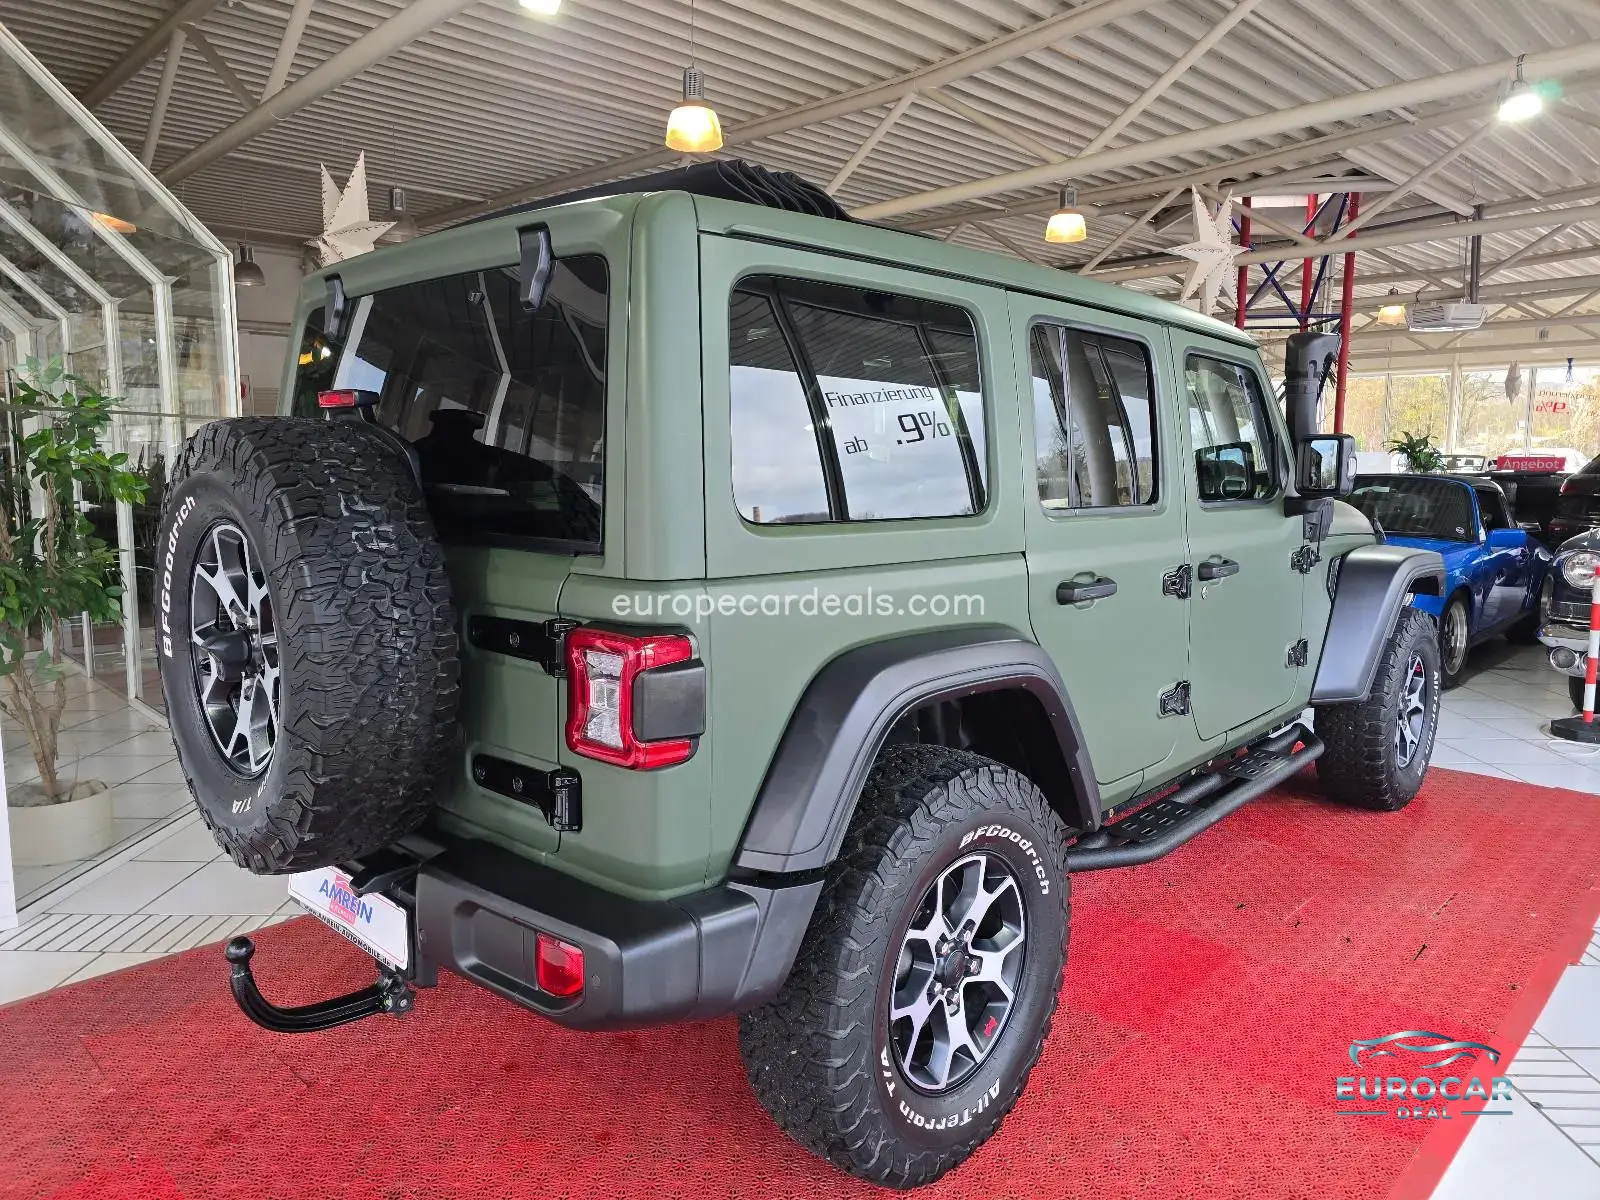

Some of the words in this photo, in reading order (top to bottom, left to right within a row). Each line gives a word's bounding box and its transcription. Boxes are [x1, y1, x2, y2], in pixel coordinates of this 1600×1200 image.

[825, 386, 934, 408] Finanzierung
[844, 436, 869, 455] ab
[1503, 458, 1560, 471] Angebot
[162, 495, 196, 658] BFGoodrich
[231, 796, 252, 814] T/A
[958, 824, 1051, 896] BFGoodrich
[319, 879, 373, 924] AMREIN
[899, 1077, 1001, 1131] All-Terrain
